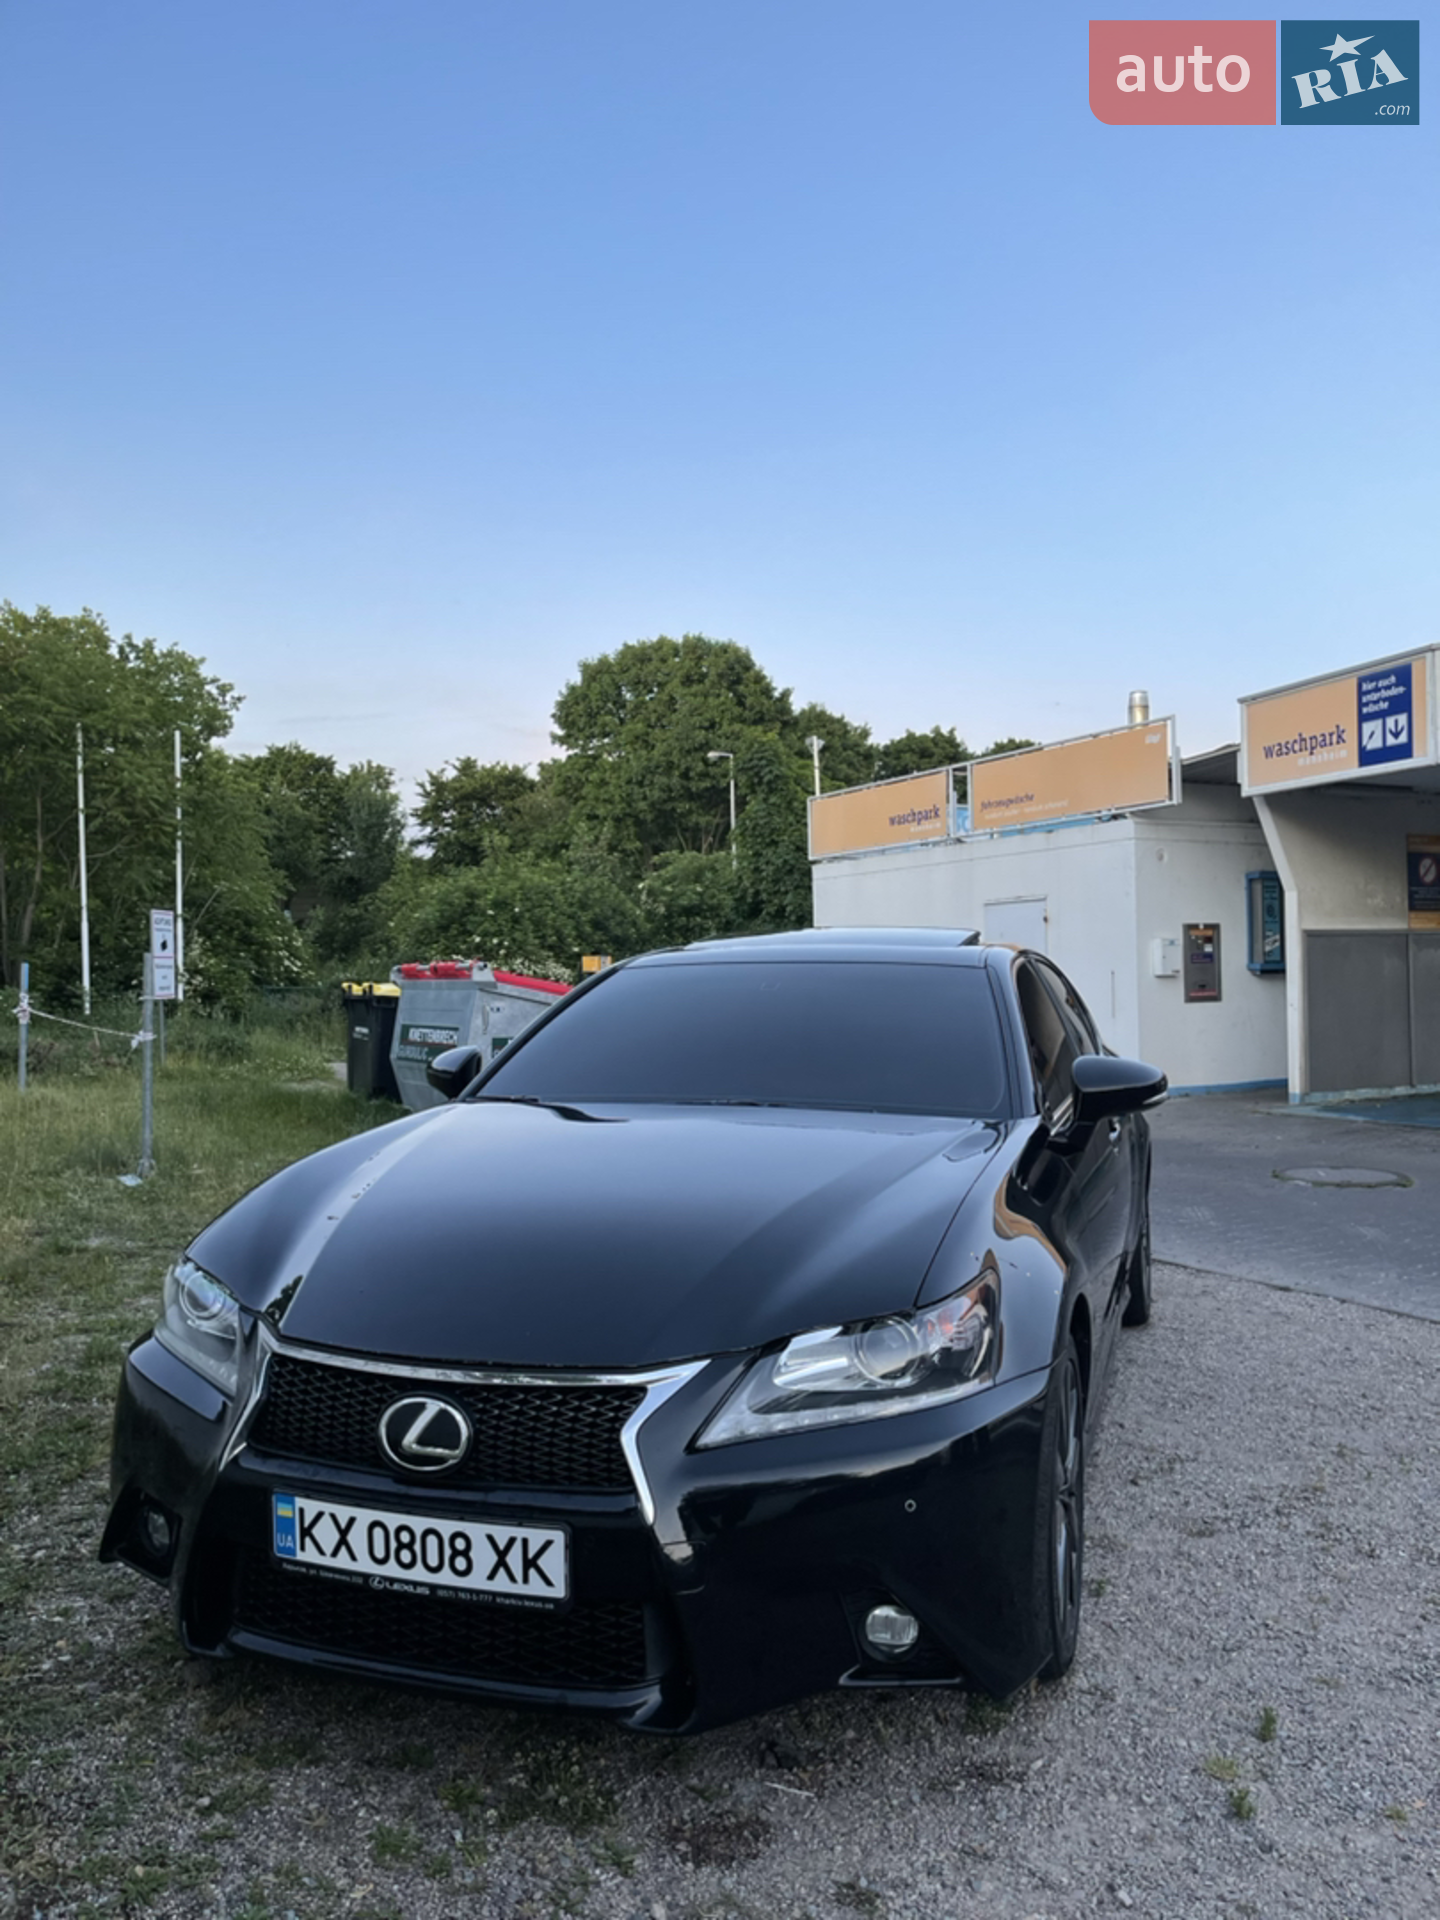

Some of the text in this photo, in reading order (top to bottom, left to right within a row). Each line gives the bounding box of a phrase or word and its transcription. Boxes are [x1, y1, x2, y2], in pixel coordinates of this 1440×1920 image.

[1263, 724, 1346, 759] waschpark
[889, 804, 941, 826] waschpark
[277, 1533, 294, 1548] UA
[298, 1507, 358, 1562] KX
[367, 1520, 473, 1577] 0808
[485, 1533, 555, 1588] XK
[386, 1580, 430, 1595] LEXUS
